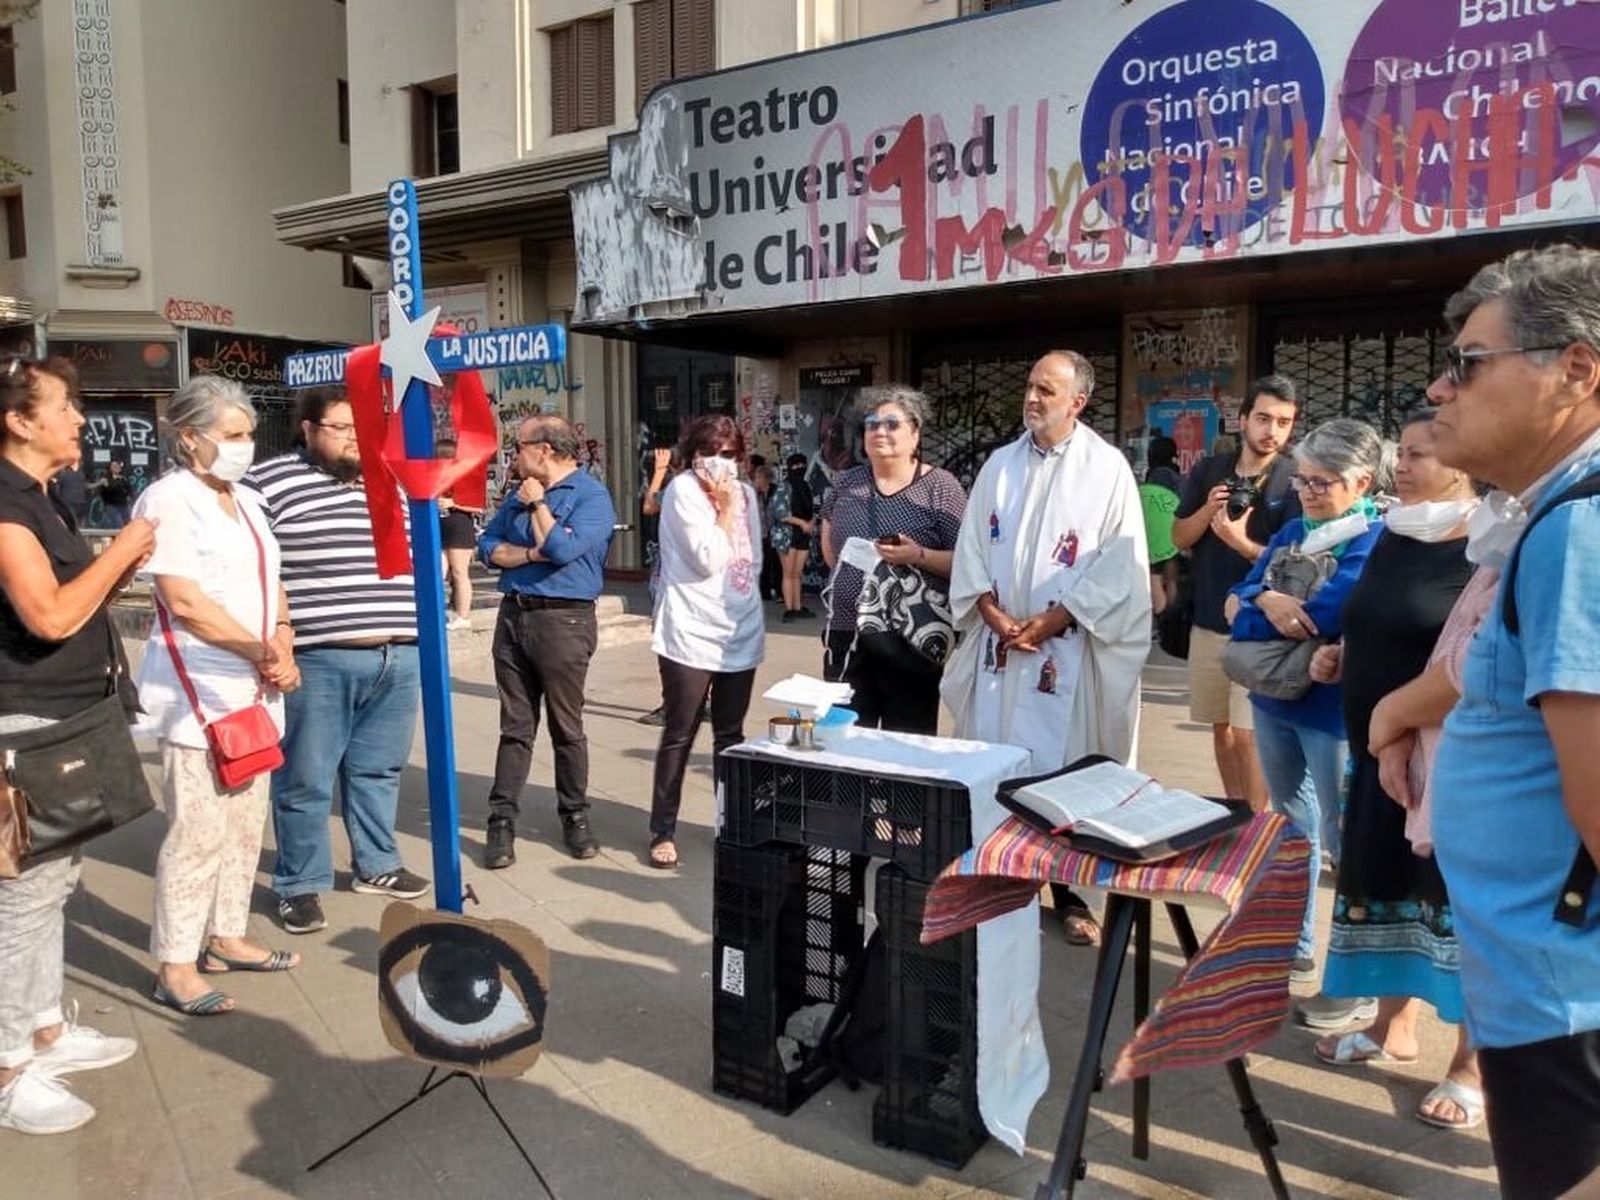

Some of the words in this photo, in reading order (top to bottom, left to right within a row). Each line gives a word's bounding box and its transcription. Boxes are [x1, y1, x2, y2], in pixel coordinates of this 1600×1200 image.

[1458, 0, 1578, 28] Balle
[1121, 38, 1278, 84] Orquesta
[1373, 29, 1548, 83] Nacional
[684, 85, 839, 148] Teatro
[1144, 77, 1301, 126] Sinfónica
[689, 114, 998, 219] Universiad
[1104, 126, 1245, 174] Nacional
[754, 221, 881, 286] Chile
[442, 338, 461, 358] LA
[463, 330, 550, 366] JUSTICIA
